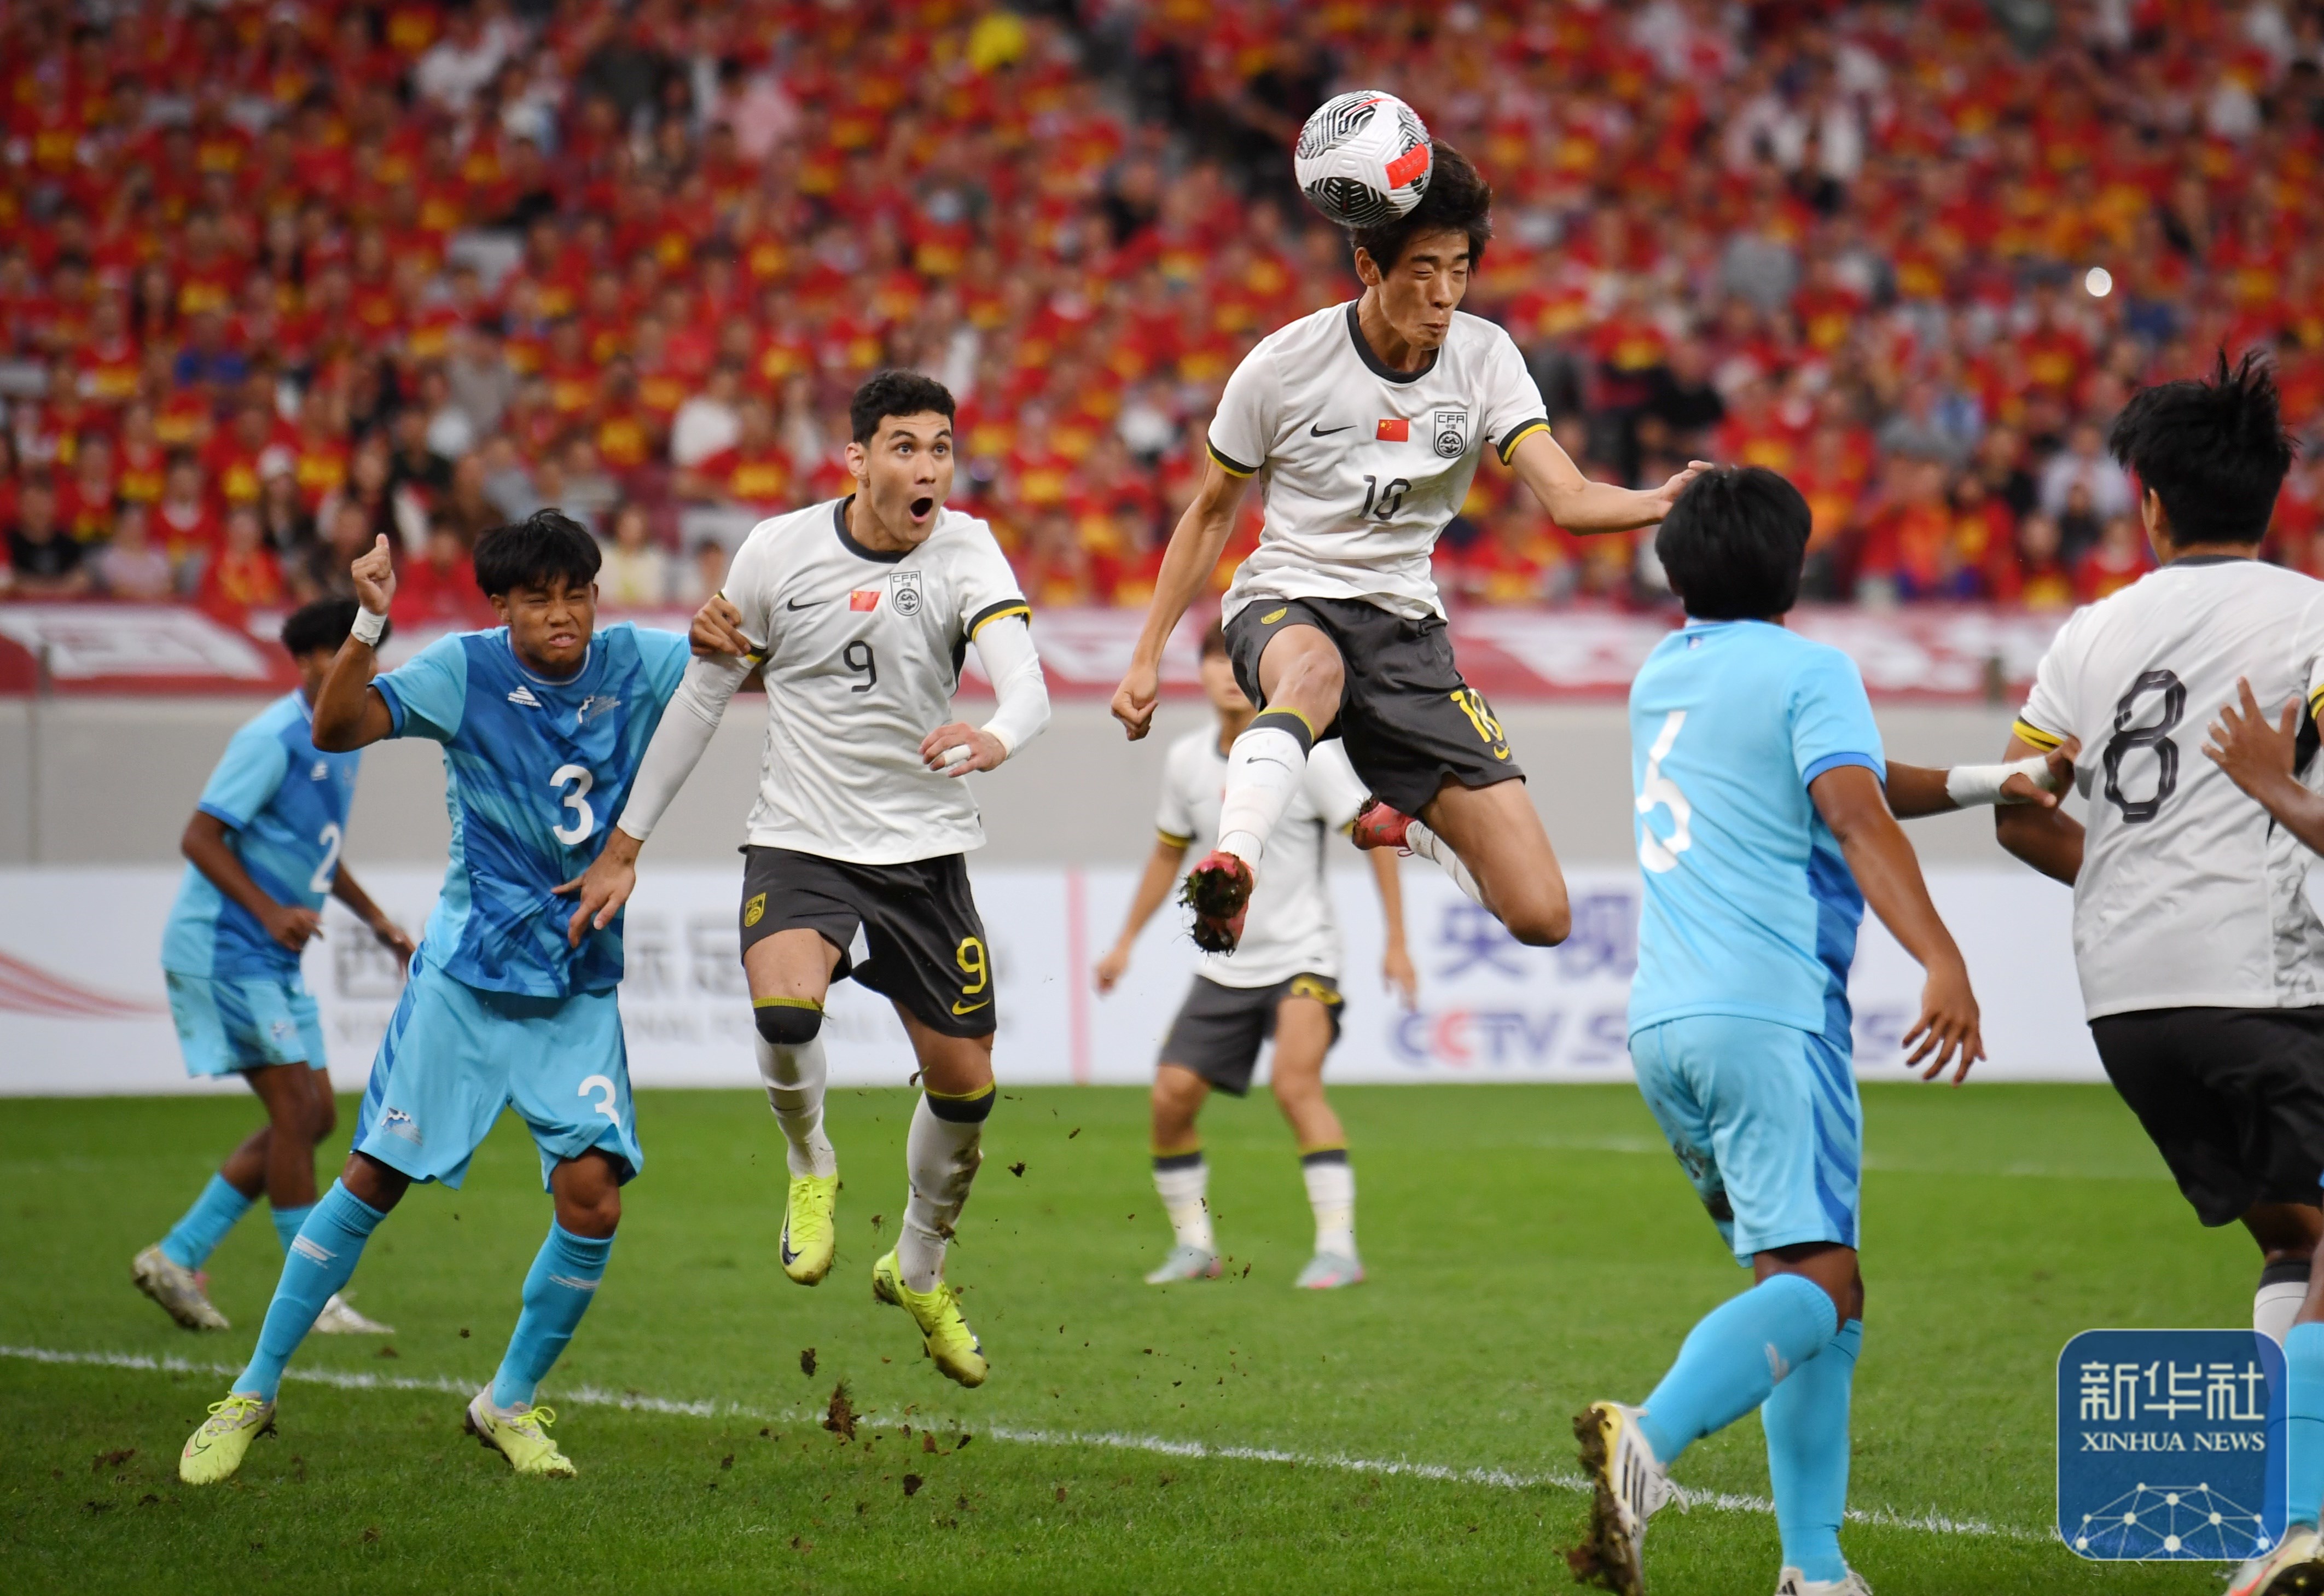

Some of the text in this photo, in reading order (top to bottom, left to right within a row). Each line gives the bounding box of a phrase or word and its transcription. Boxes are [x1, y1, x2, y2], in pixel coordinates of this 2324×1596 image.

[1437, 415, 1465, 423] CFA
[892, 573, 919, 583] CFA
[843, 640, 876, 693] 9
[2102, 669, 2187, 823] 8
[549, 764, 594, 845] 3
[1635, 711, 1692, 874] 6
[309, 822, 341, 893] 2
[956, 937, 986, 995] 9
[577, 1075, 620, 1128] 3
